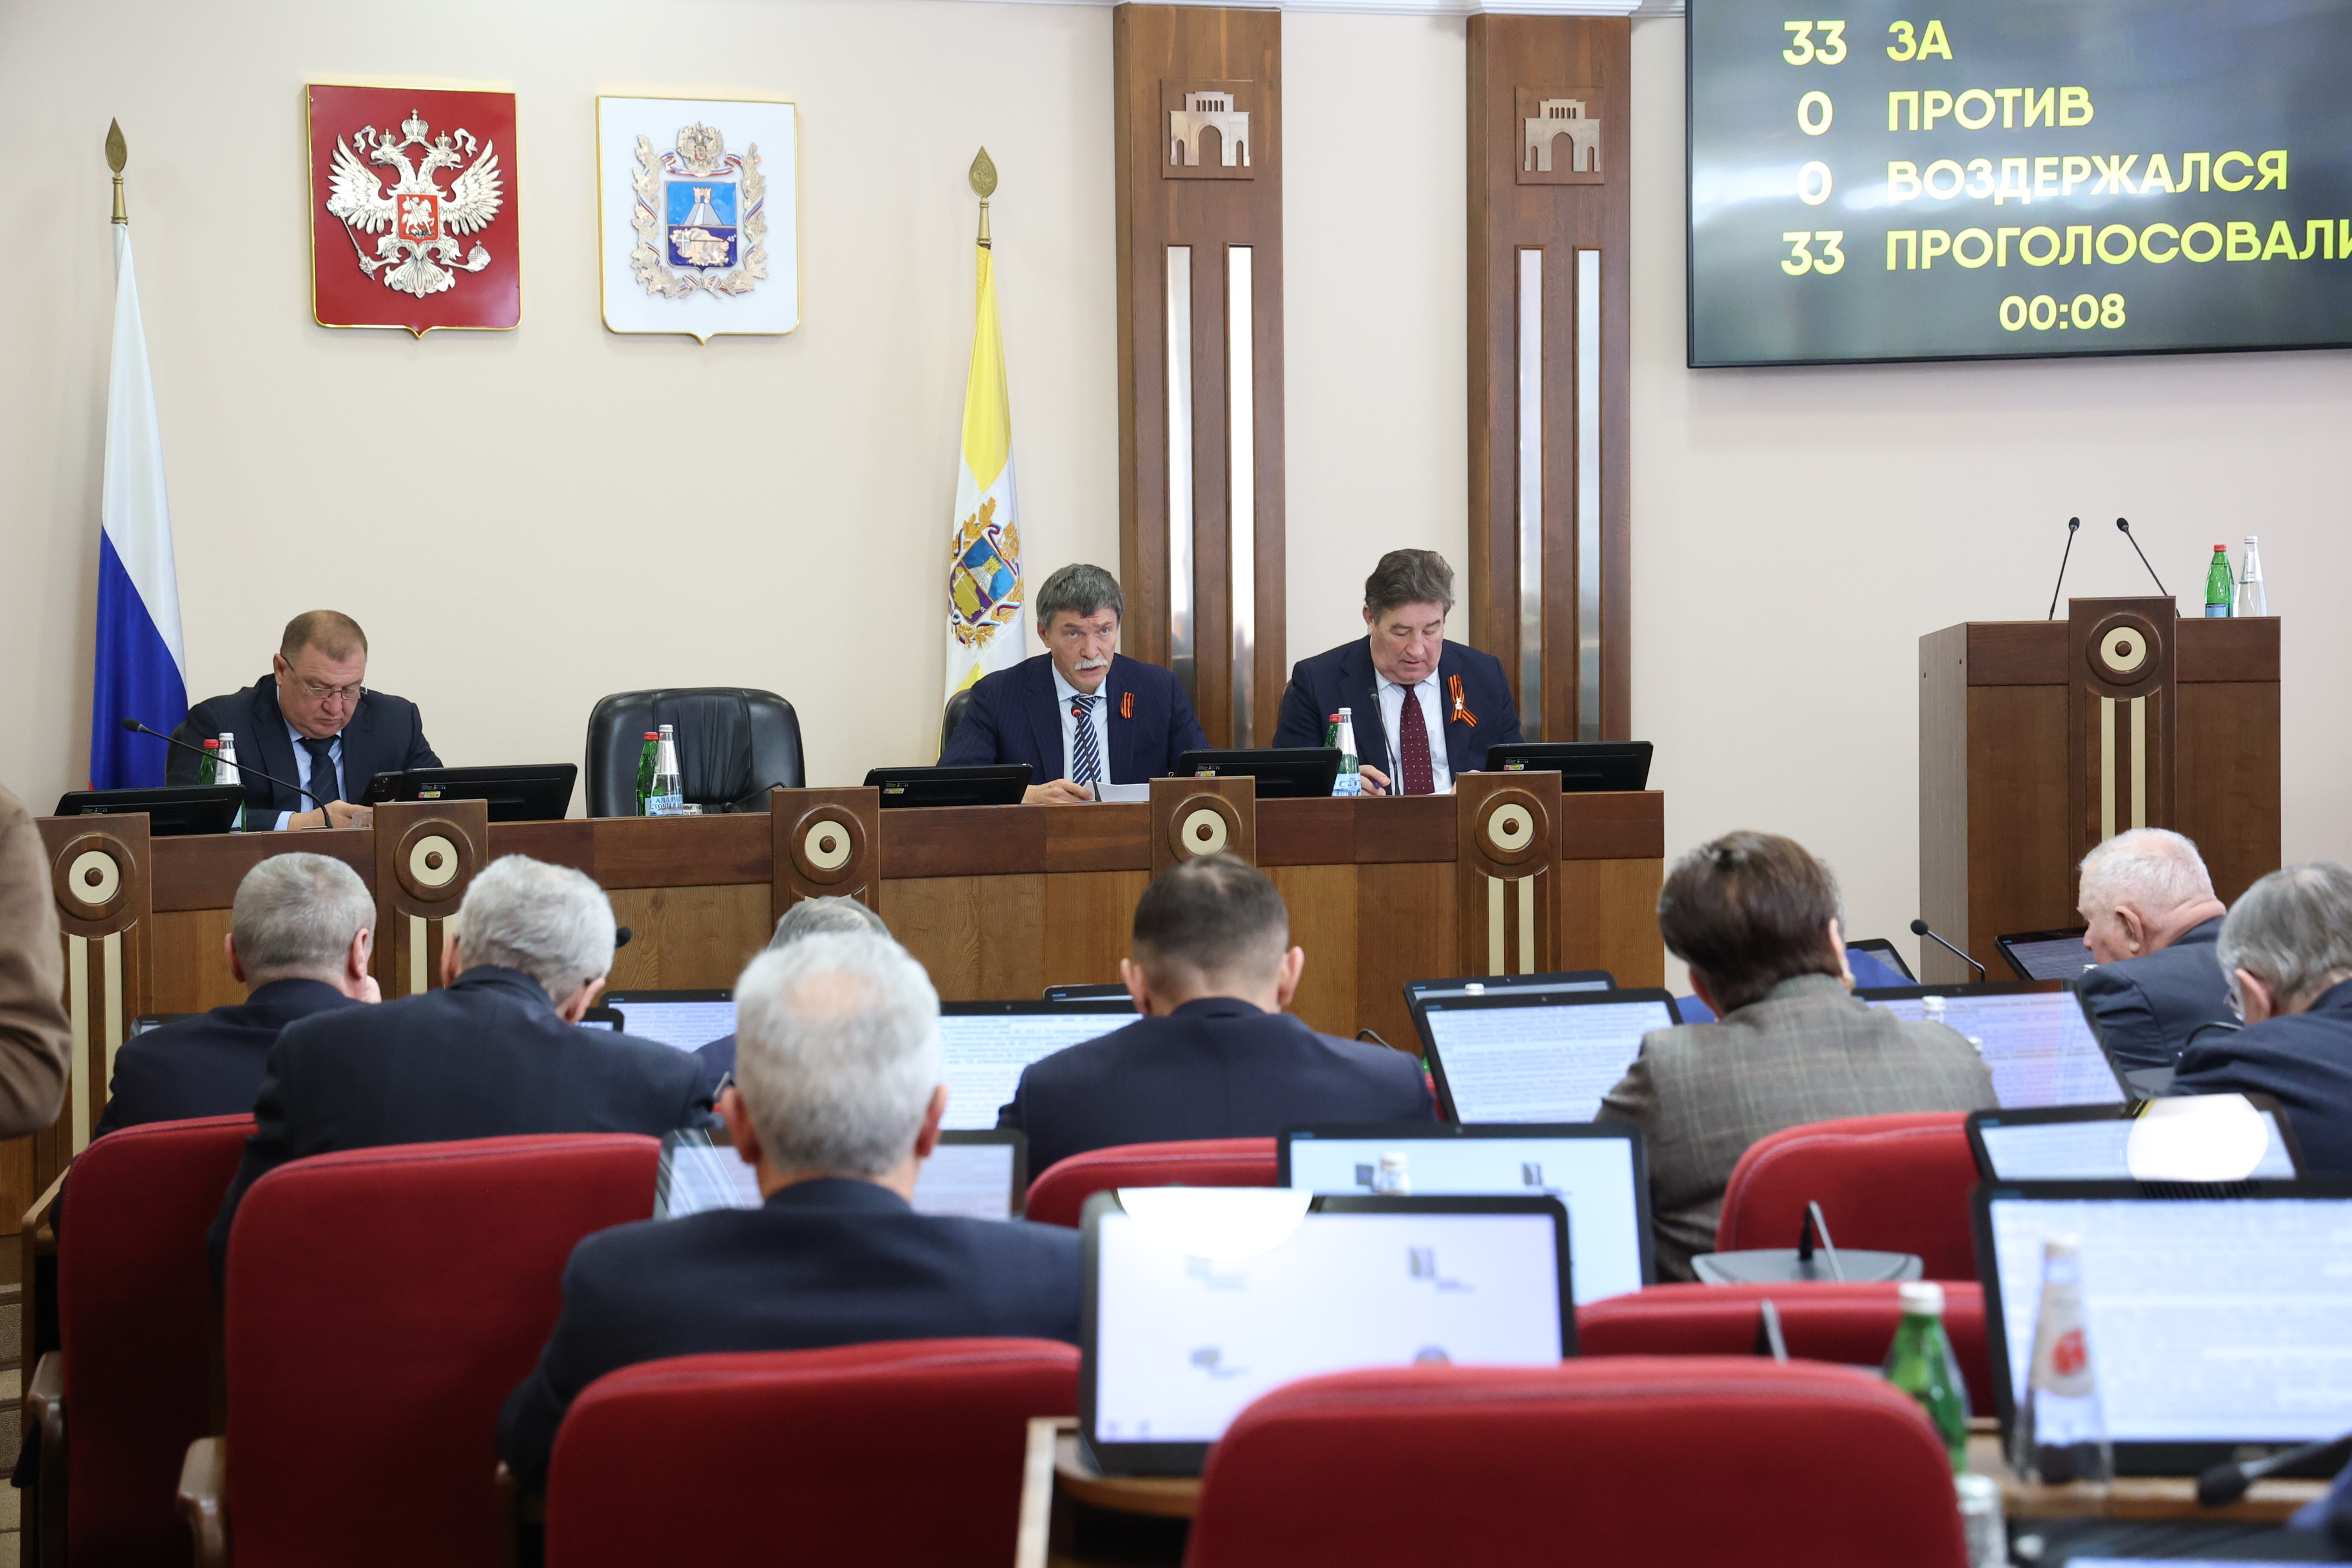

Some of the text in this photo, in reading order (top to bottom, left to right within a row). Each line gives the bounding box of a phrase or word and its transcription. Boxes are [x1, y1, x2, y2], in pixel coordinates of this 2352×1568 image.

[1783, 20, 1954, 66] 33 ЗА
[1798, 86, 2094, 136] 0 ПРОТИВ
[1797, 150, 2288, 206] 0 ВОЗДЕРЖАЛСЯ
[1781, 230, 1845, 276] 33
[1999, 293, 2126, 332] 00:08
